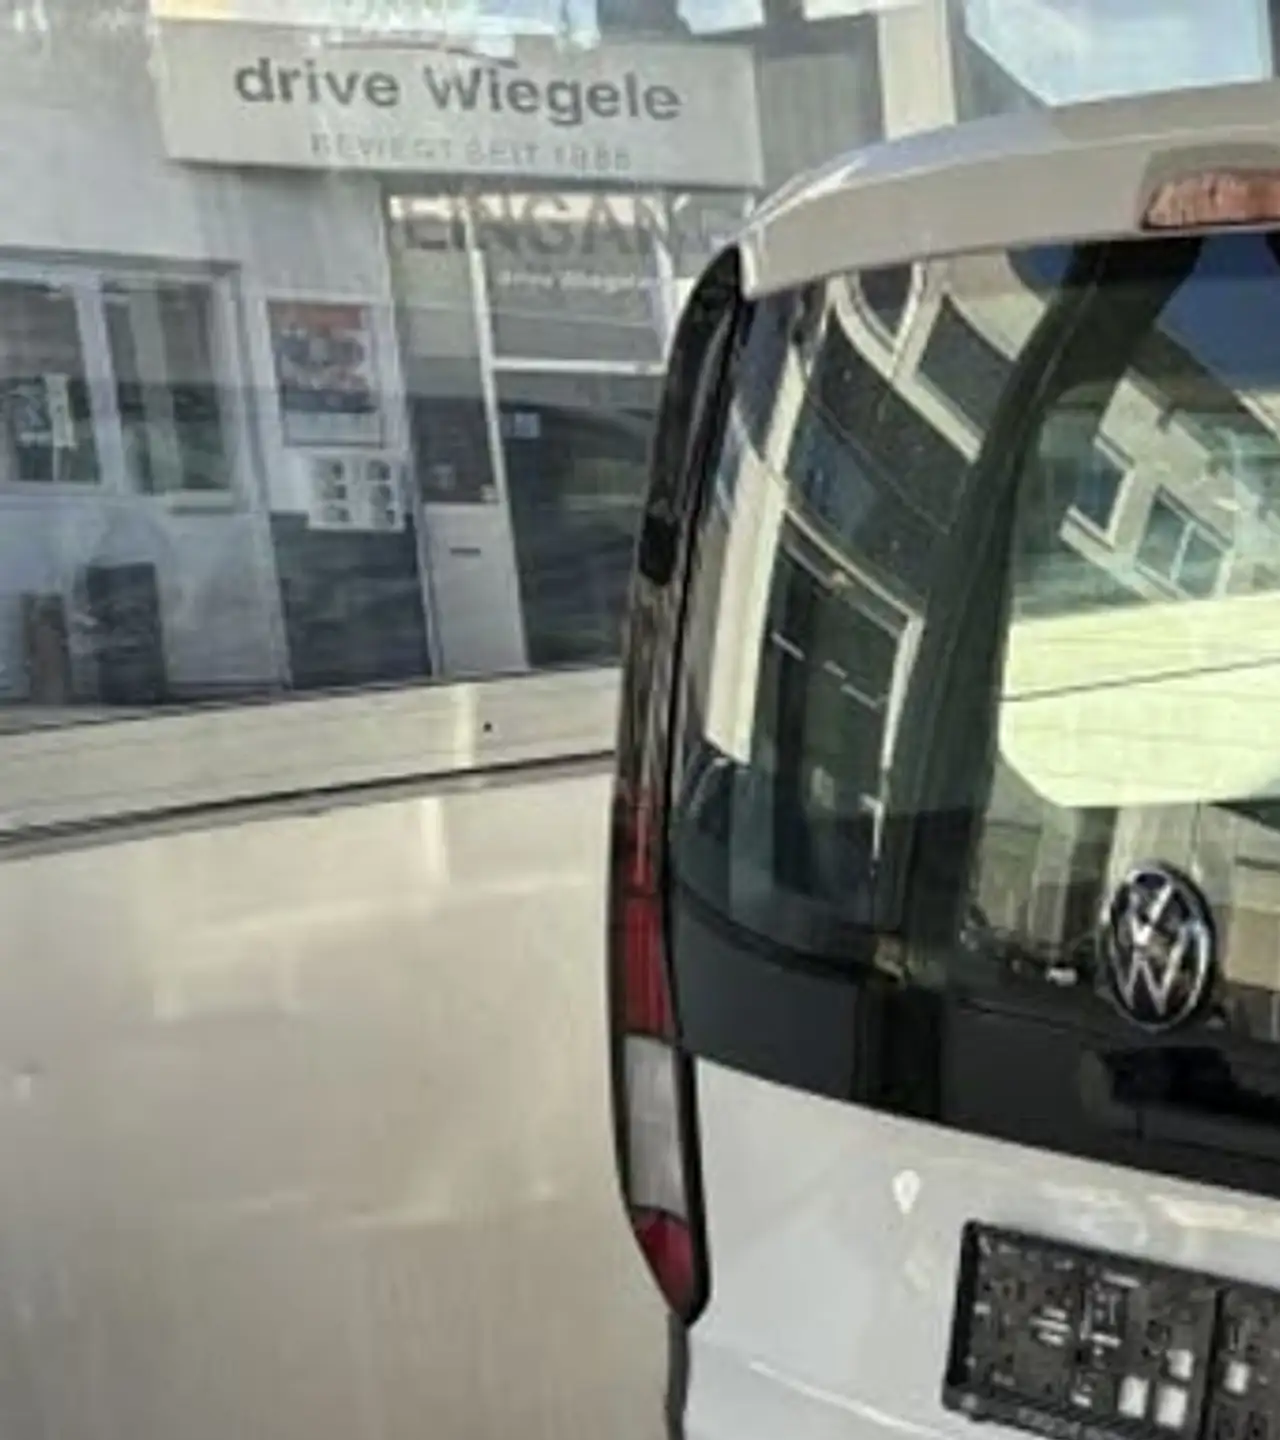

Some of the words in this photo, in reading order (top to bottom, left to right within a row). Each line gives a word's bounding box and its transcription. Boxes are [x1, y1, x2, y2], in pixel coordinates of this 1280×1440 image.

[234, 57, 400, 108] drive
[421, 64, 683, 128] Wiegele
[403, 193, 708, 257] EINGAN
